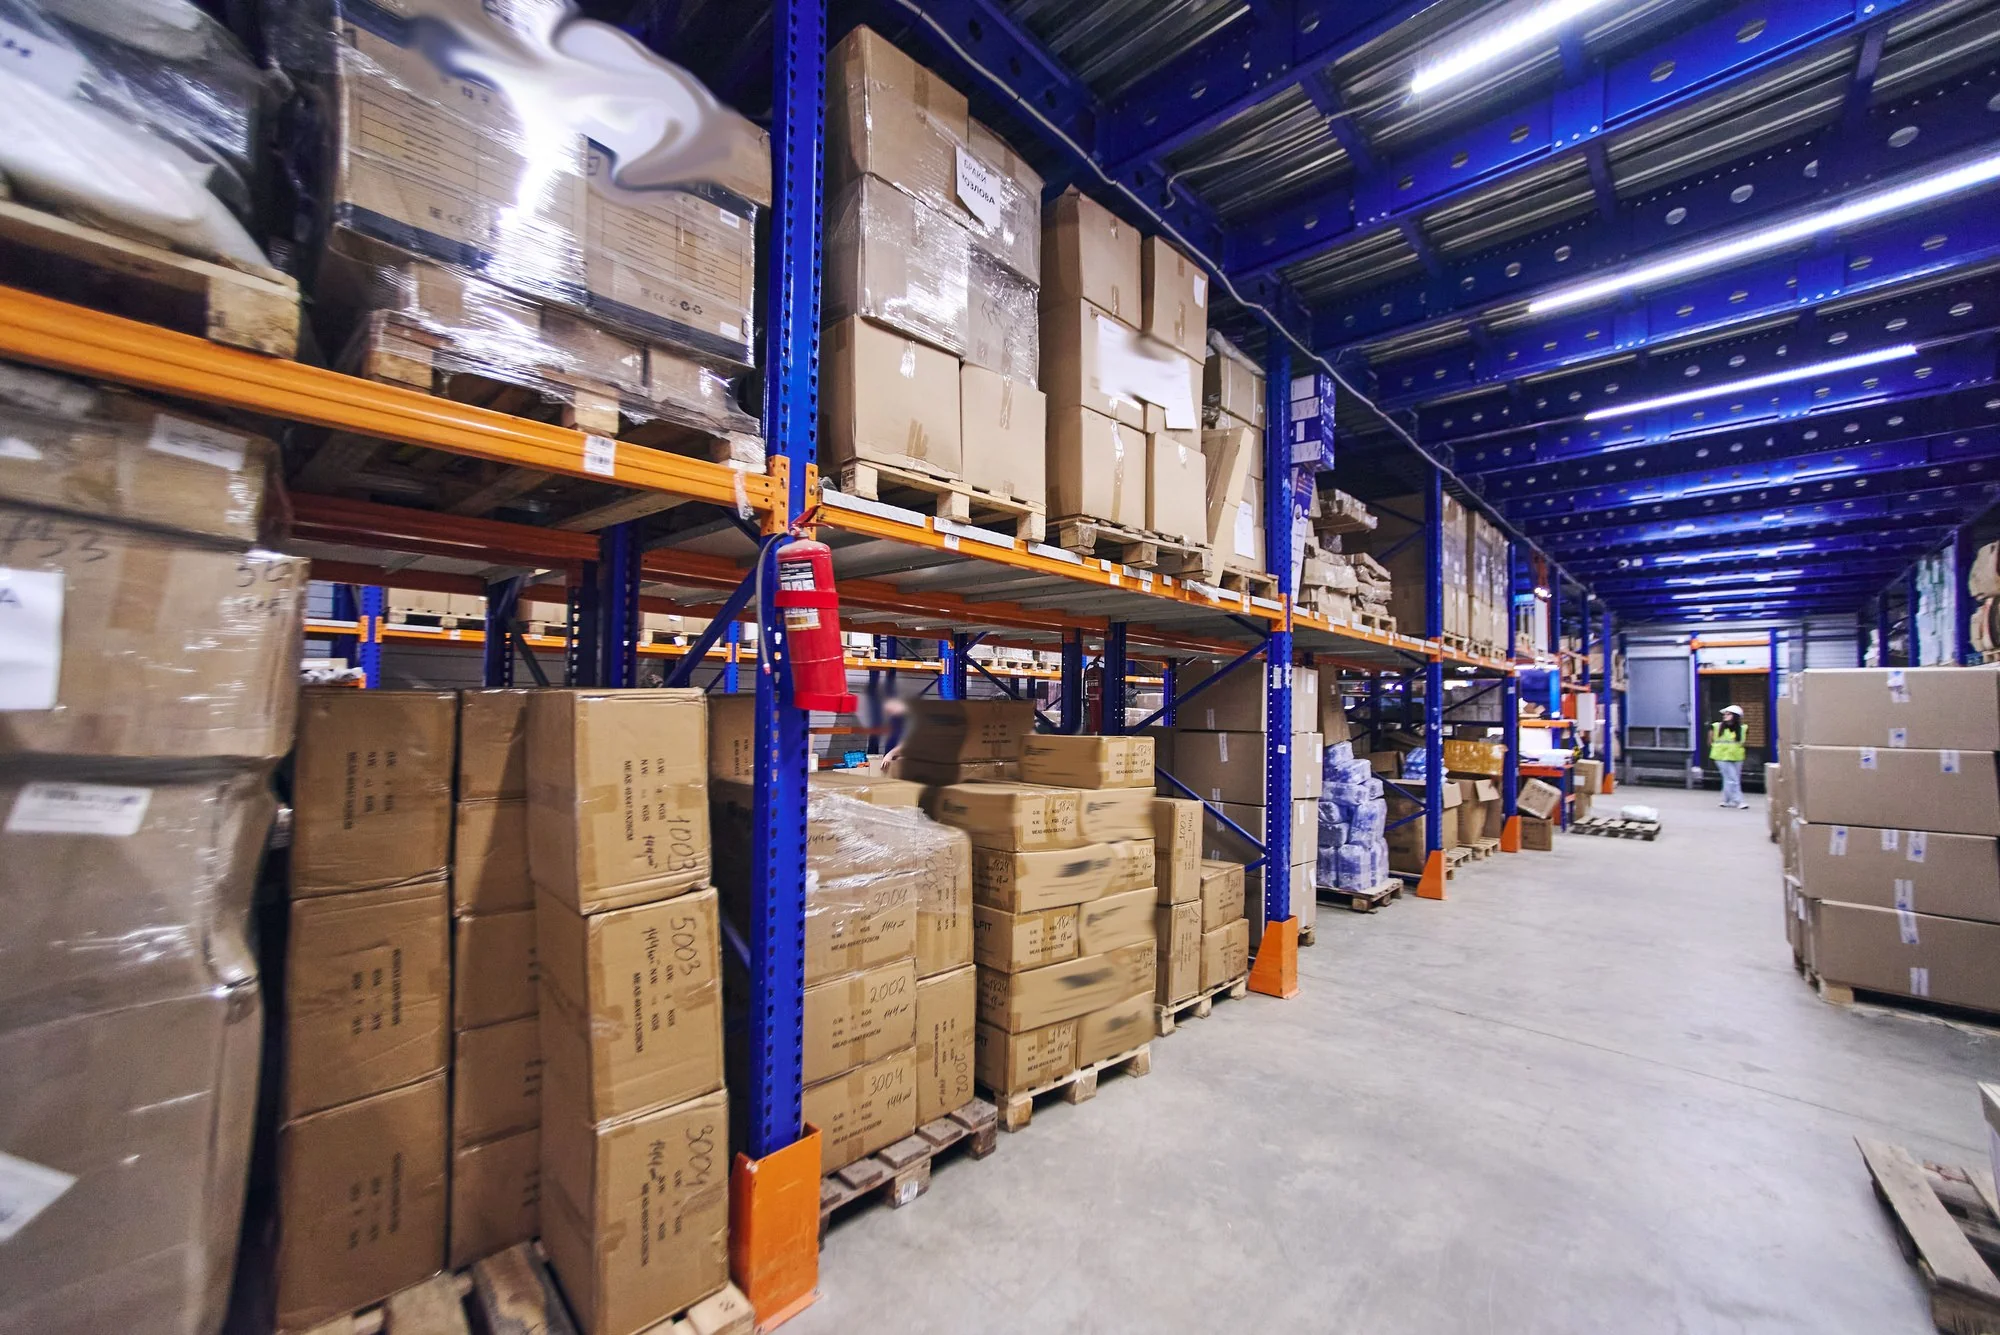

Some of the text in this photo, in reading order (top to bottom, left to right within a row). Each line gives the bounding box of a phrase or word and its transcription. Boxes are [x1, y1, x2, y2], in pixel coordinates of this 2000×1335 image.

[667, 815, 697, 871] 1003
[870, 888, 907, 915] 3004
[670, 917, 701, 976] 5003
[870, 975, 906, 1004] 2002
[869, 1067, 903, 1097] 3004
[954, 1053, 969, 1097] 2002
